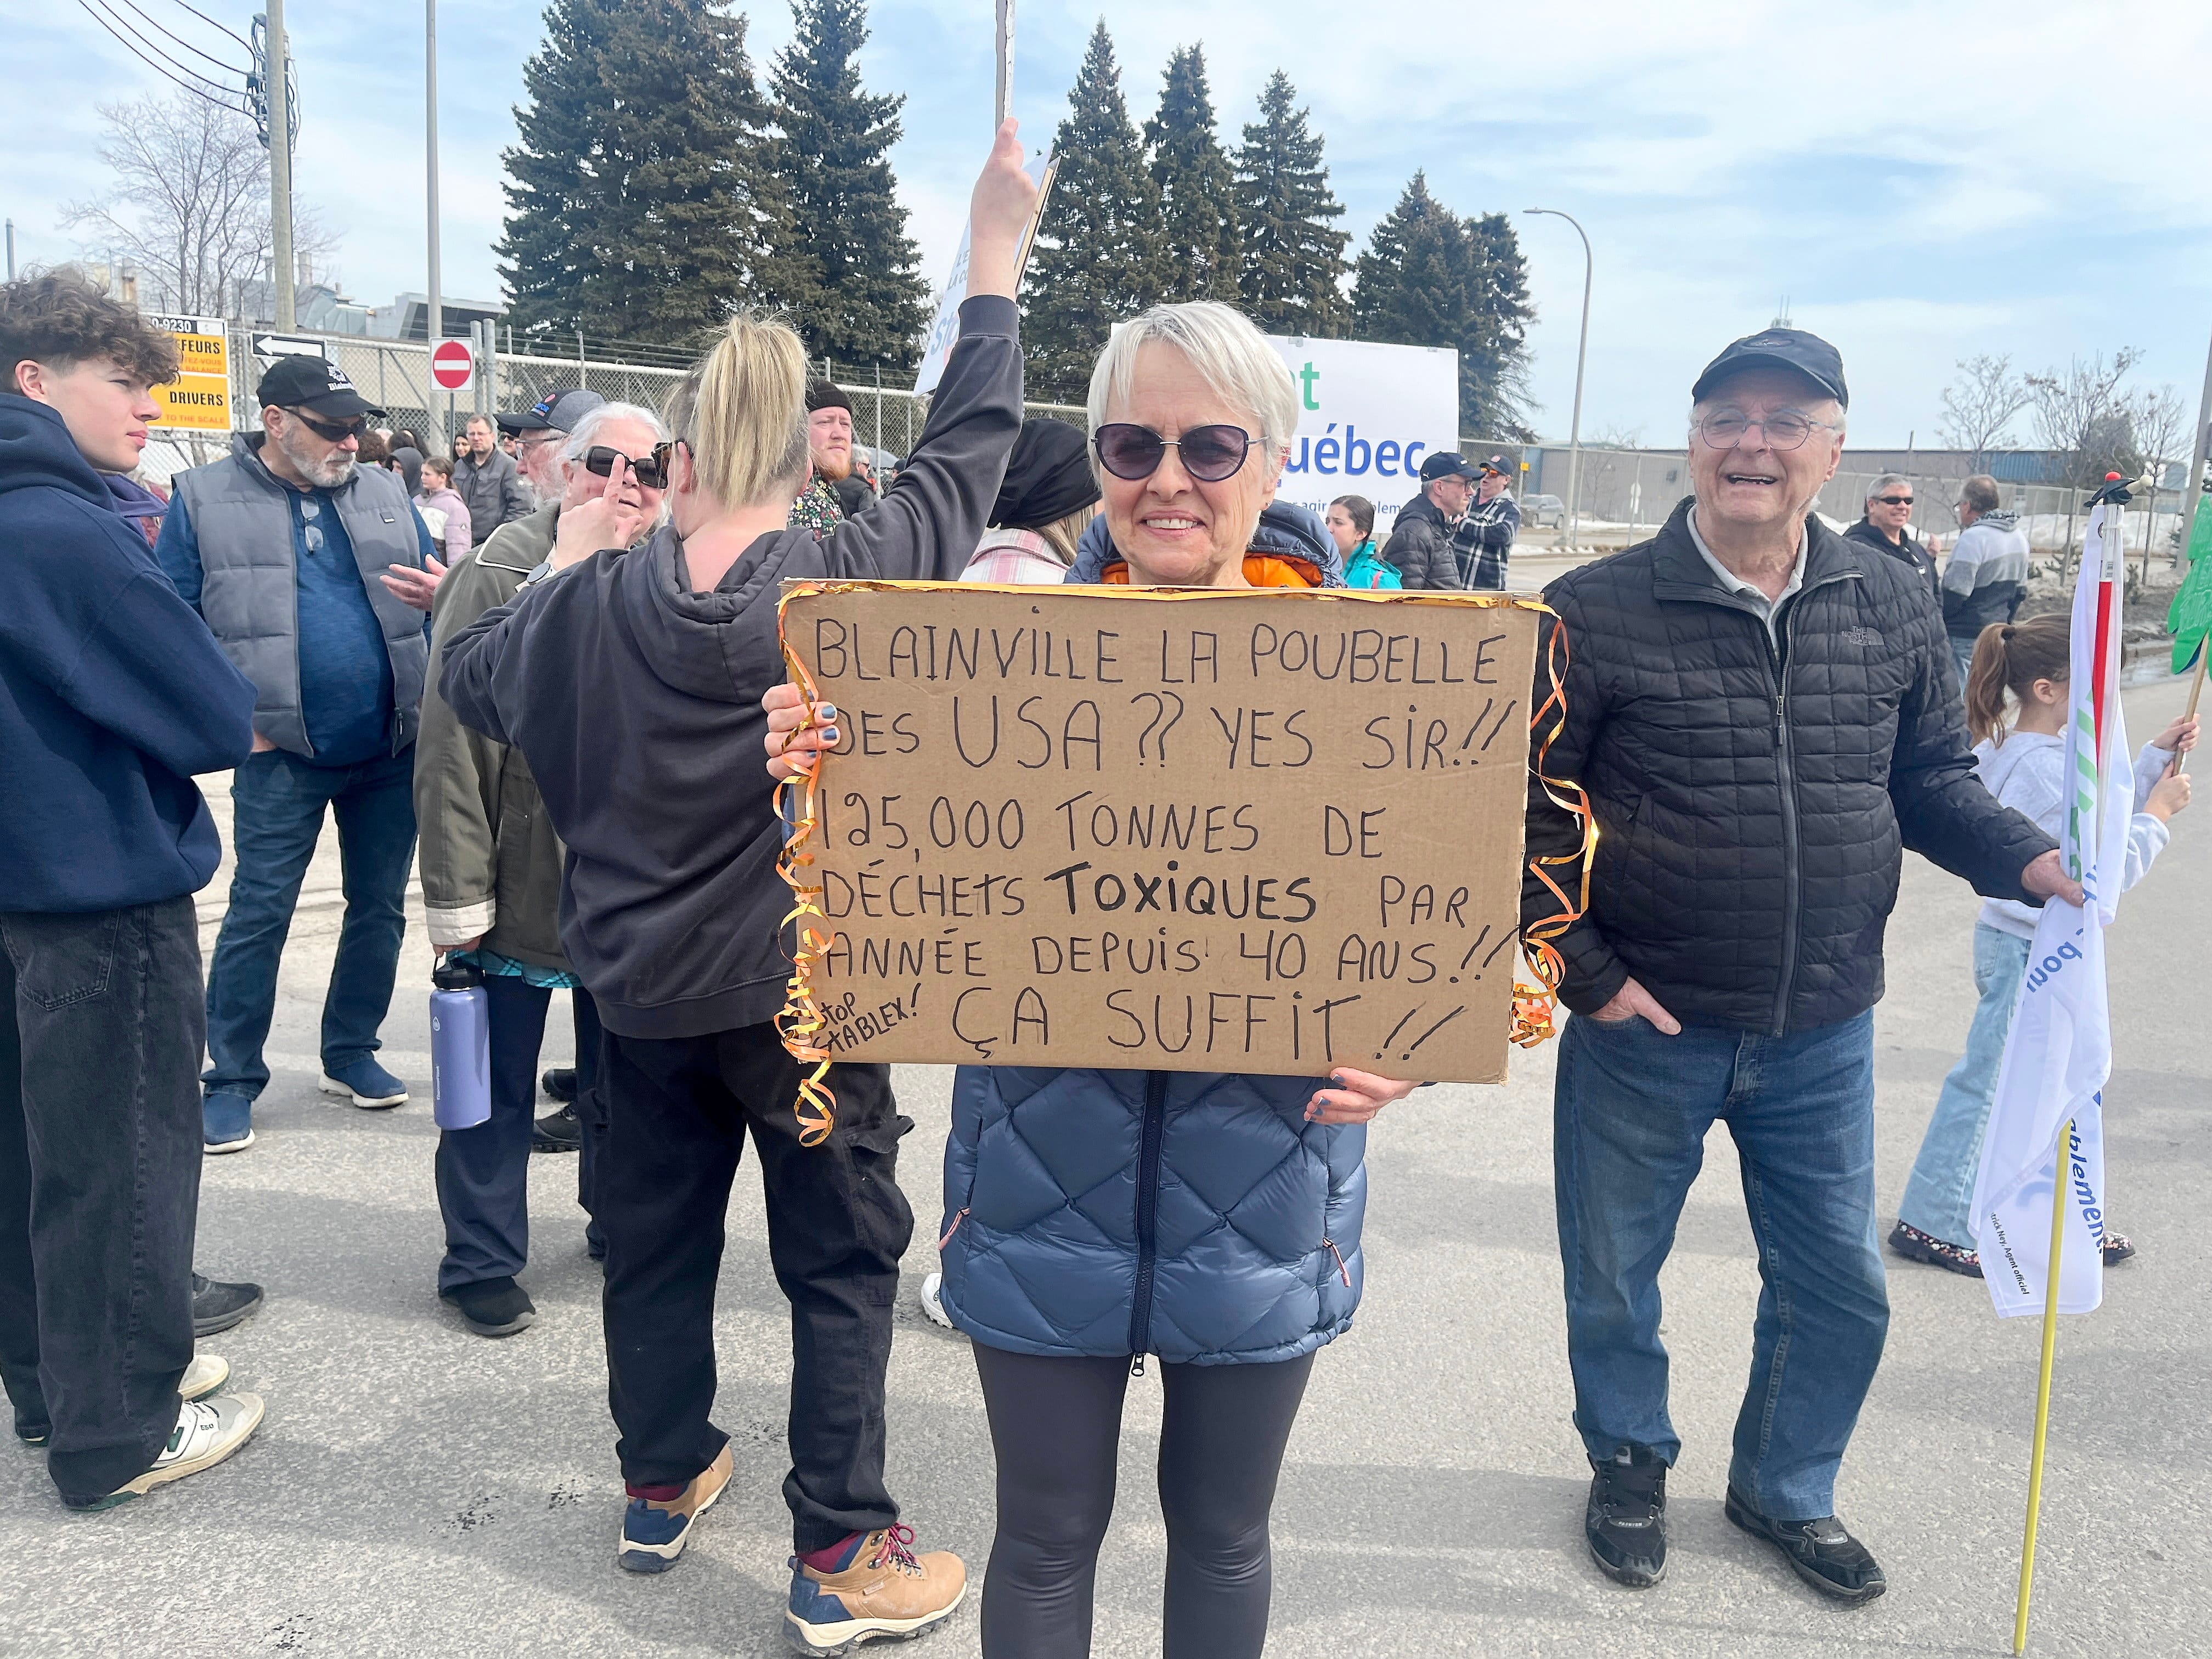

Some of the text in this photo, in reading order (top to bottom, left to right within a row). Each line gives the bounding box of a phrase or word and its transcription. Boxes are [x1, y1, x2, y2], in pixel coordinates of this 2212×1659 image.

[170, 391, 223, 406] DRIVERS
[1278, 423, 1425, 487] uébec
[1161, 629, 1217, 684] LA
[1250, 623, 1506, 684] POUBELLE
[1842, 630, 1867, 640] NORTH
[953, 695, 1101, 771] USA
[1210, 707, 1313, 770] YES
[821, 788, 1386, 863] 125,000 TONNES DE
[1380, 875, 1469, 928] PAR
[827, 928, 986, 978] ANNÉE
[1240, 930, 1306, 981] 40
[952, 986, 1048, 1059] ÇA
[1990, 1212, 2002, 1231] trick
[2004, 1247, 2018, 1269] Agent
[2014, 1269, 2030, 1295] officiel
